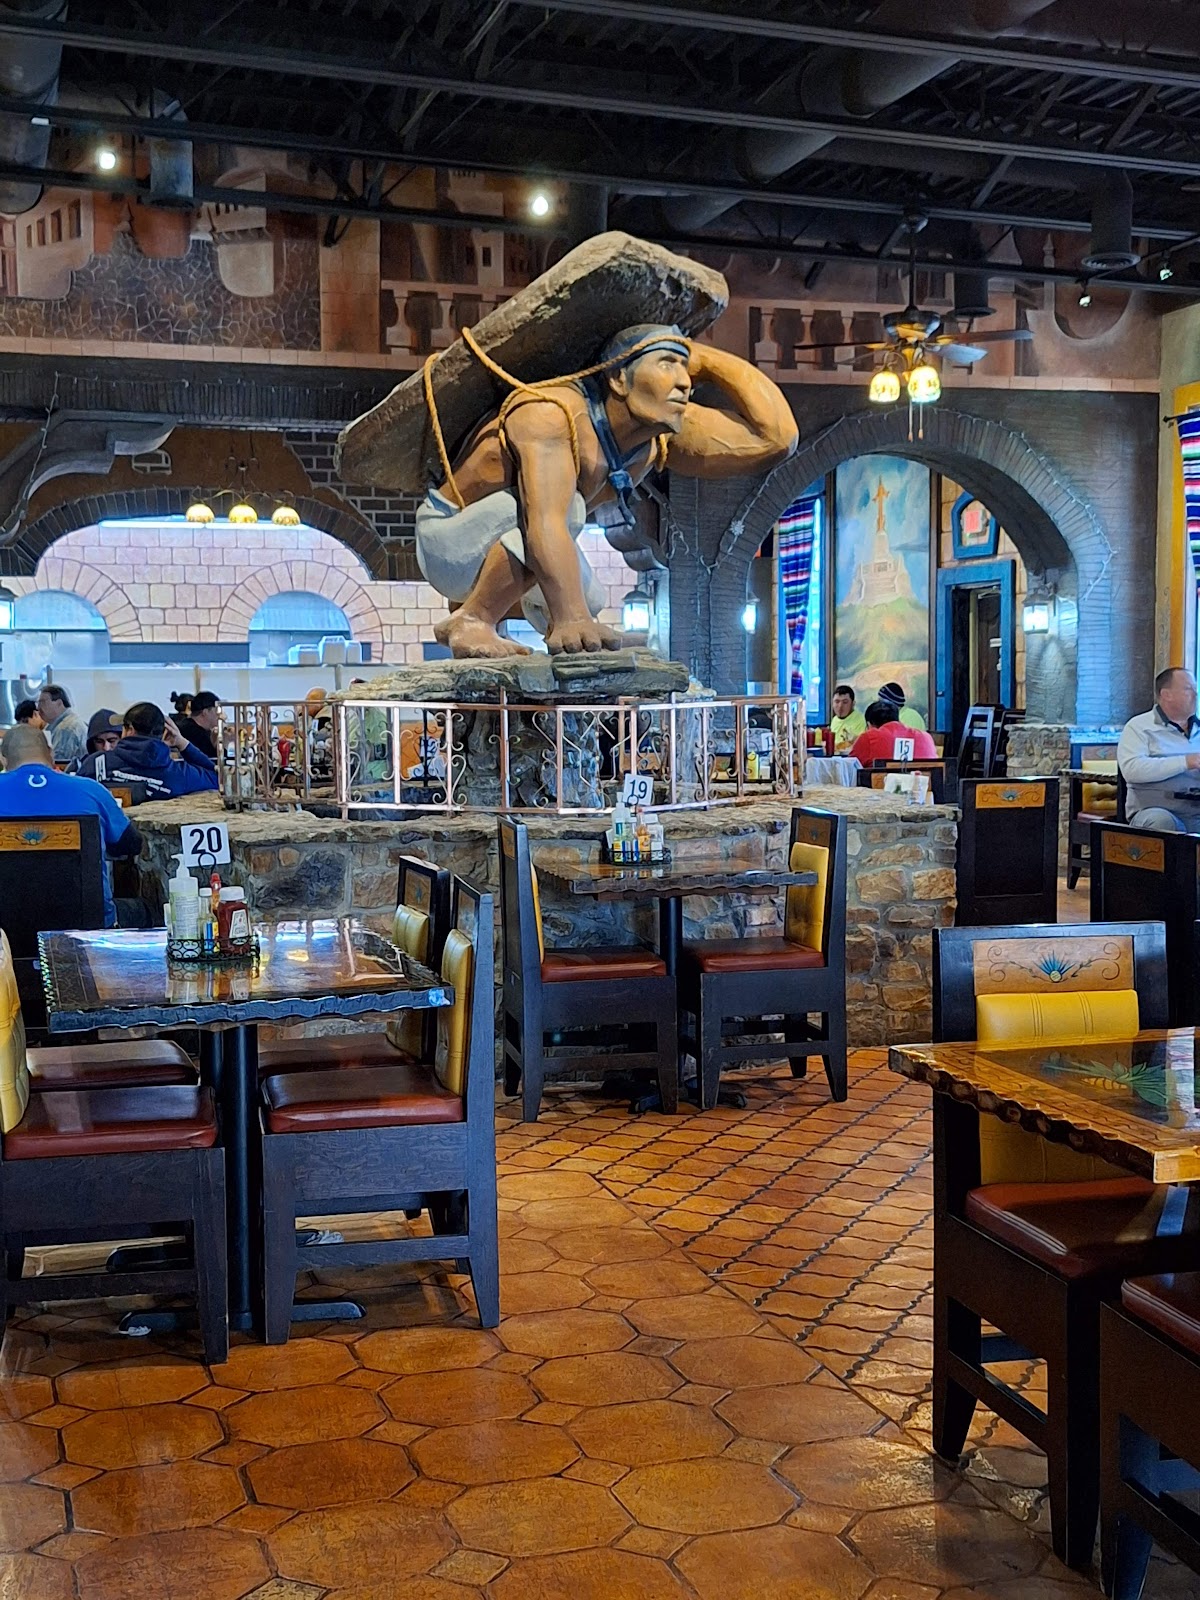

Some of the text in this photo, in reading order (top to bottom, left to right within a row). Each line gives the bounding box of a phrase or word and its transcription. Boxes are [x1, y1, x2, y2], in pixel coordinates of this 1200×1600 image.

[899, 740, 910, 755] 15
[629, 779, 648, 799] 19
[189, 826, 223, 855] 20
